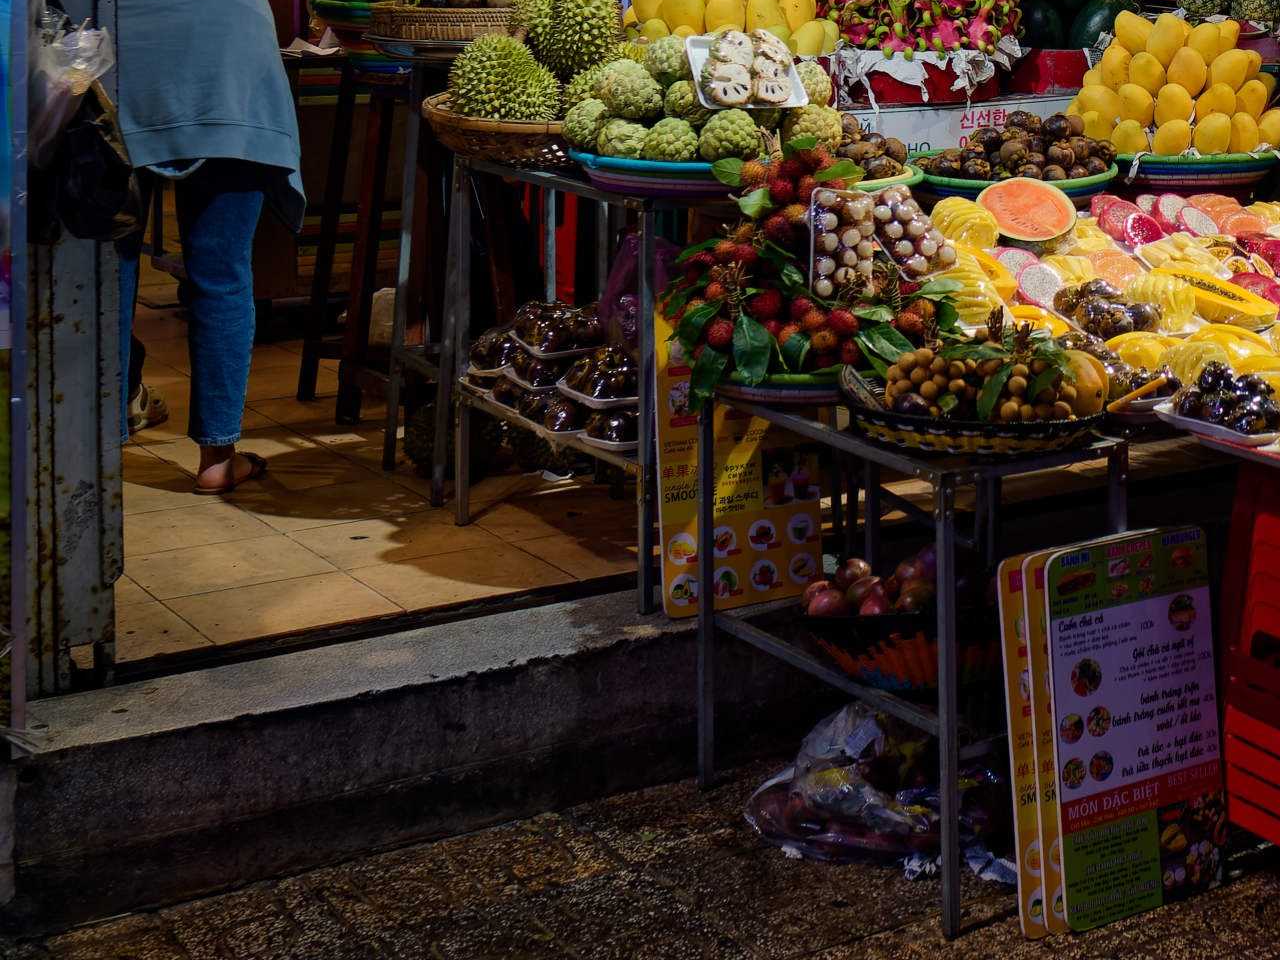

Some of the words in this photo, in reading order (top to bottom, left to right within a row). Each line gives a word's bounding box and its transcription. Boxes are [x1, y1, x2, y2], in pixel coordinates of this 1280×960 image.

[960, 108, 1007, 130] 신선한
[1102, 790, 1129, 811] ĐẶC
[1133, 780, 1161, 801] BIỆT
